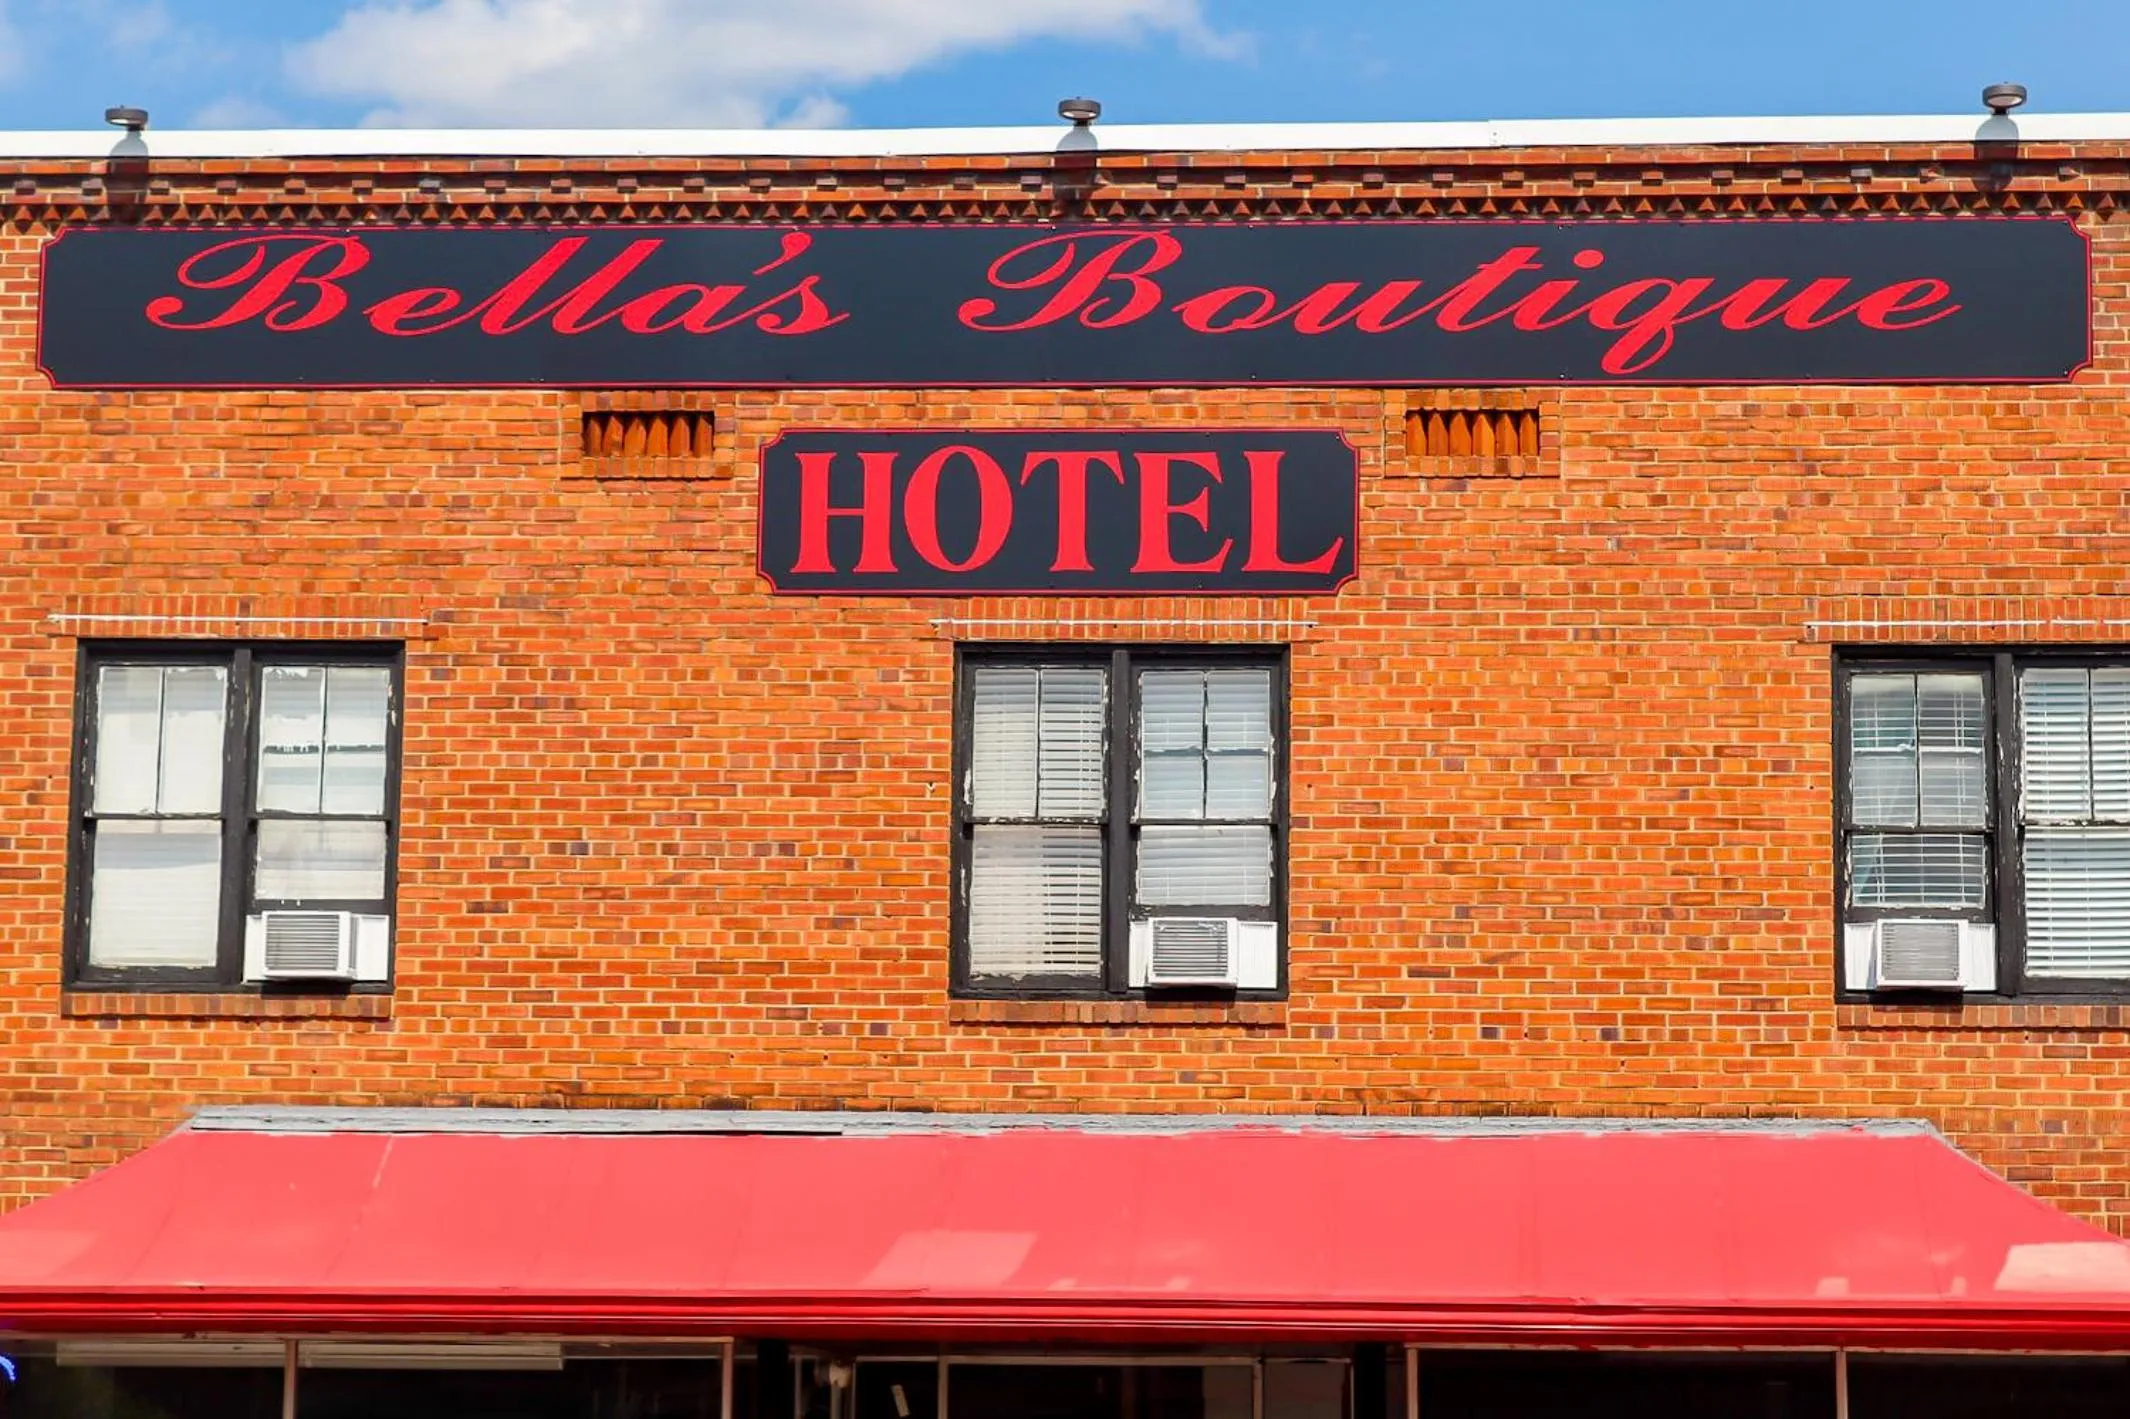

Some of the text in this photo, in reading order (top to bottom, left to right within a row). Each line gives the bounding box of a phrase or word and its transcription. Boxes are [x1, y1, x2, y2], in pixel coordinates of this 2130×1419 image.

[145, 229, 1962, 377] Bella's Boutique
[790, 445, 1342, 575] HOTEL
